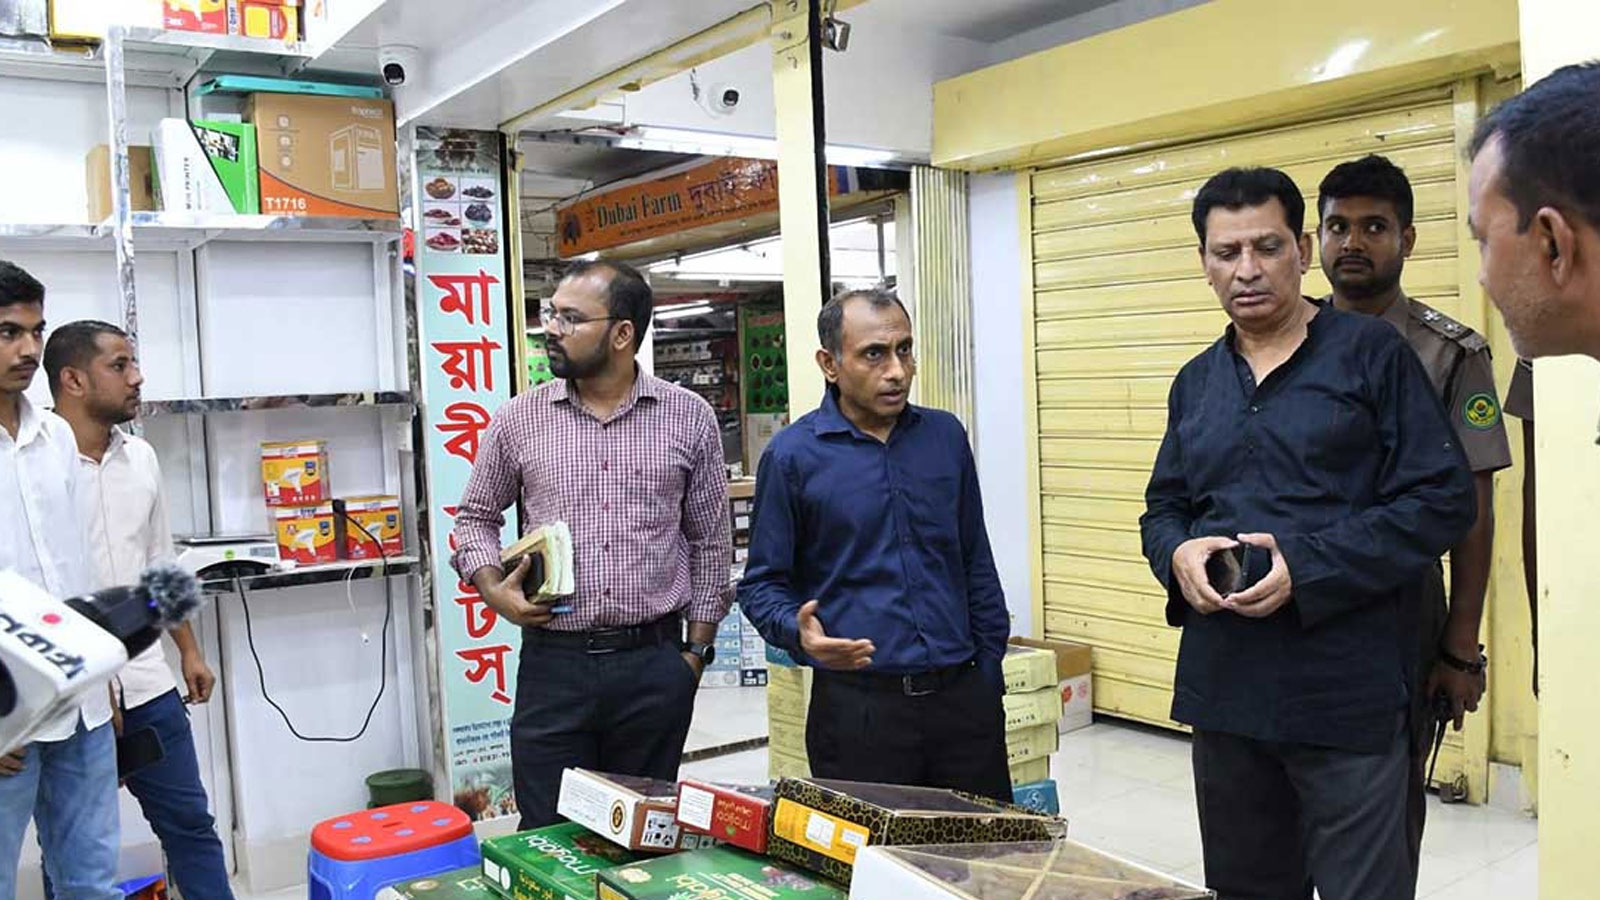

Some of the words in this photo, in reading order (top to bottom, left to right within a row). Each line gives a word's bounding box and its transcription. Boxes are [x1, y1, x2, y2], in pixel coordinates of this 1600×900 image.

[265, 197, 307, 210] T1716
[597, 197, 638, 228] Dubai
[641, 192, 682, 218] Farm
